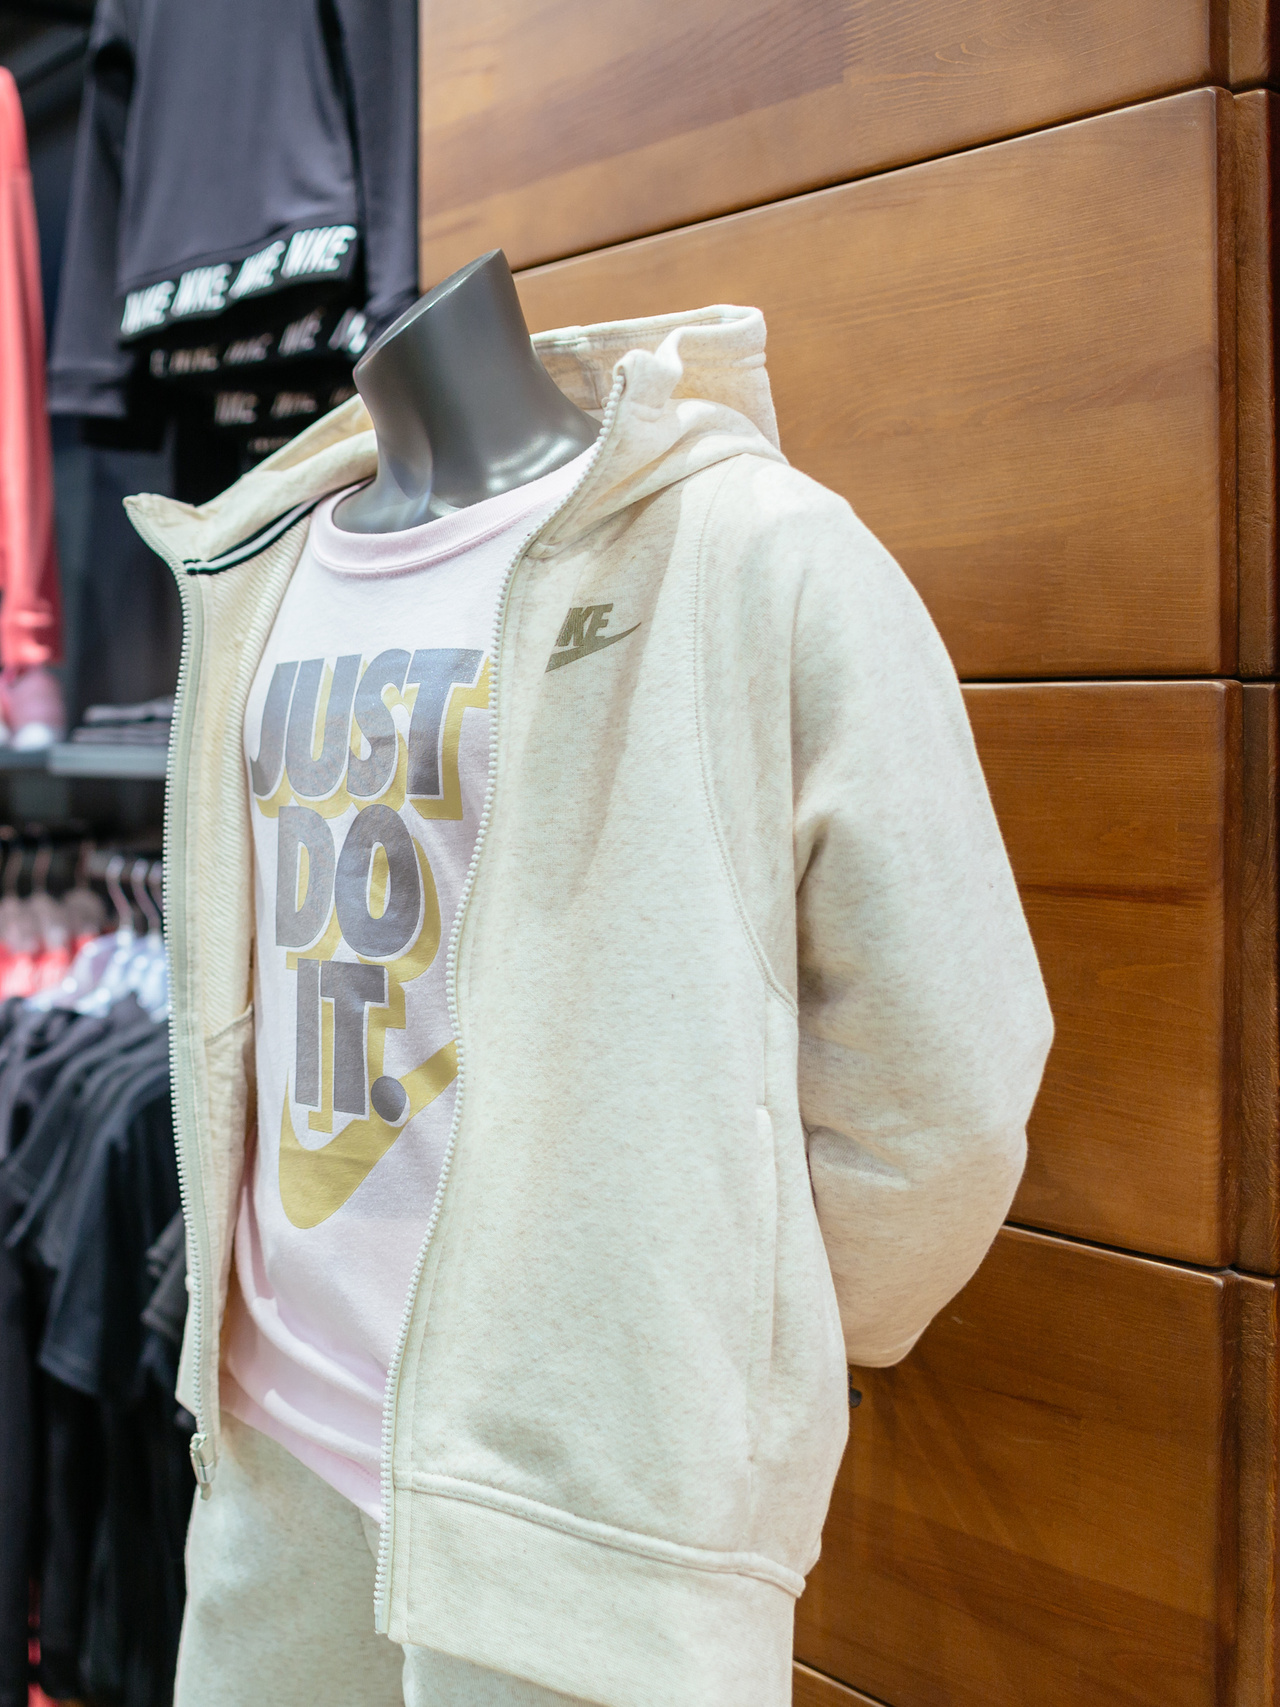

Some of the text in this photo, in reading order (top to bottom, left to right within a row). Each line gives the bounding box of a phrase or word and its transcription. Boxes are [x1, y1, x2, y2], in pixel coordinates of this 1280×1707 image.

[171, 263, 232, 317] NIKE
[279, 225, 357, 278] NIKE
[555, 603, 613, 647] KE
[251, 648, 485, 798] JUST
[275, 804, 421, 957] DO
[295, 958, 407, 1122] IT.
